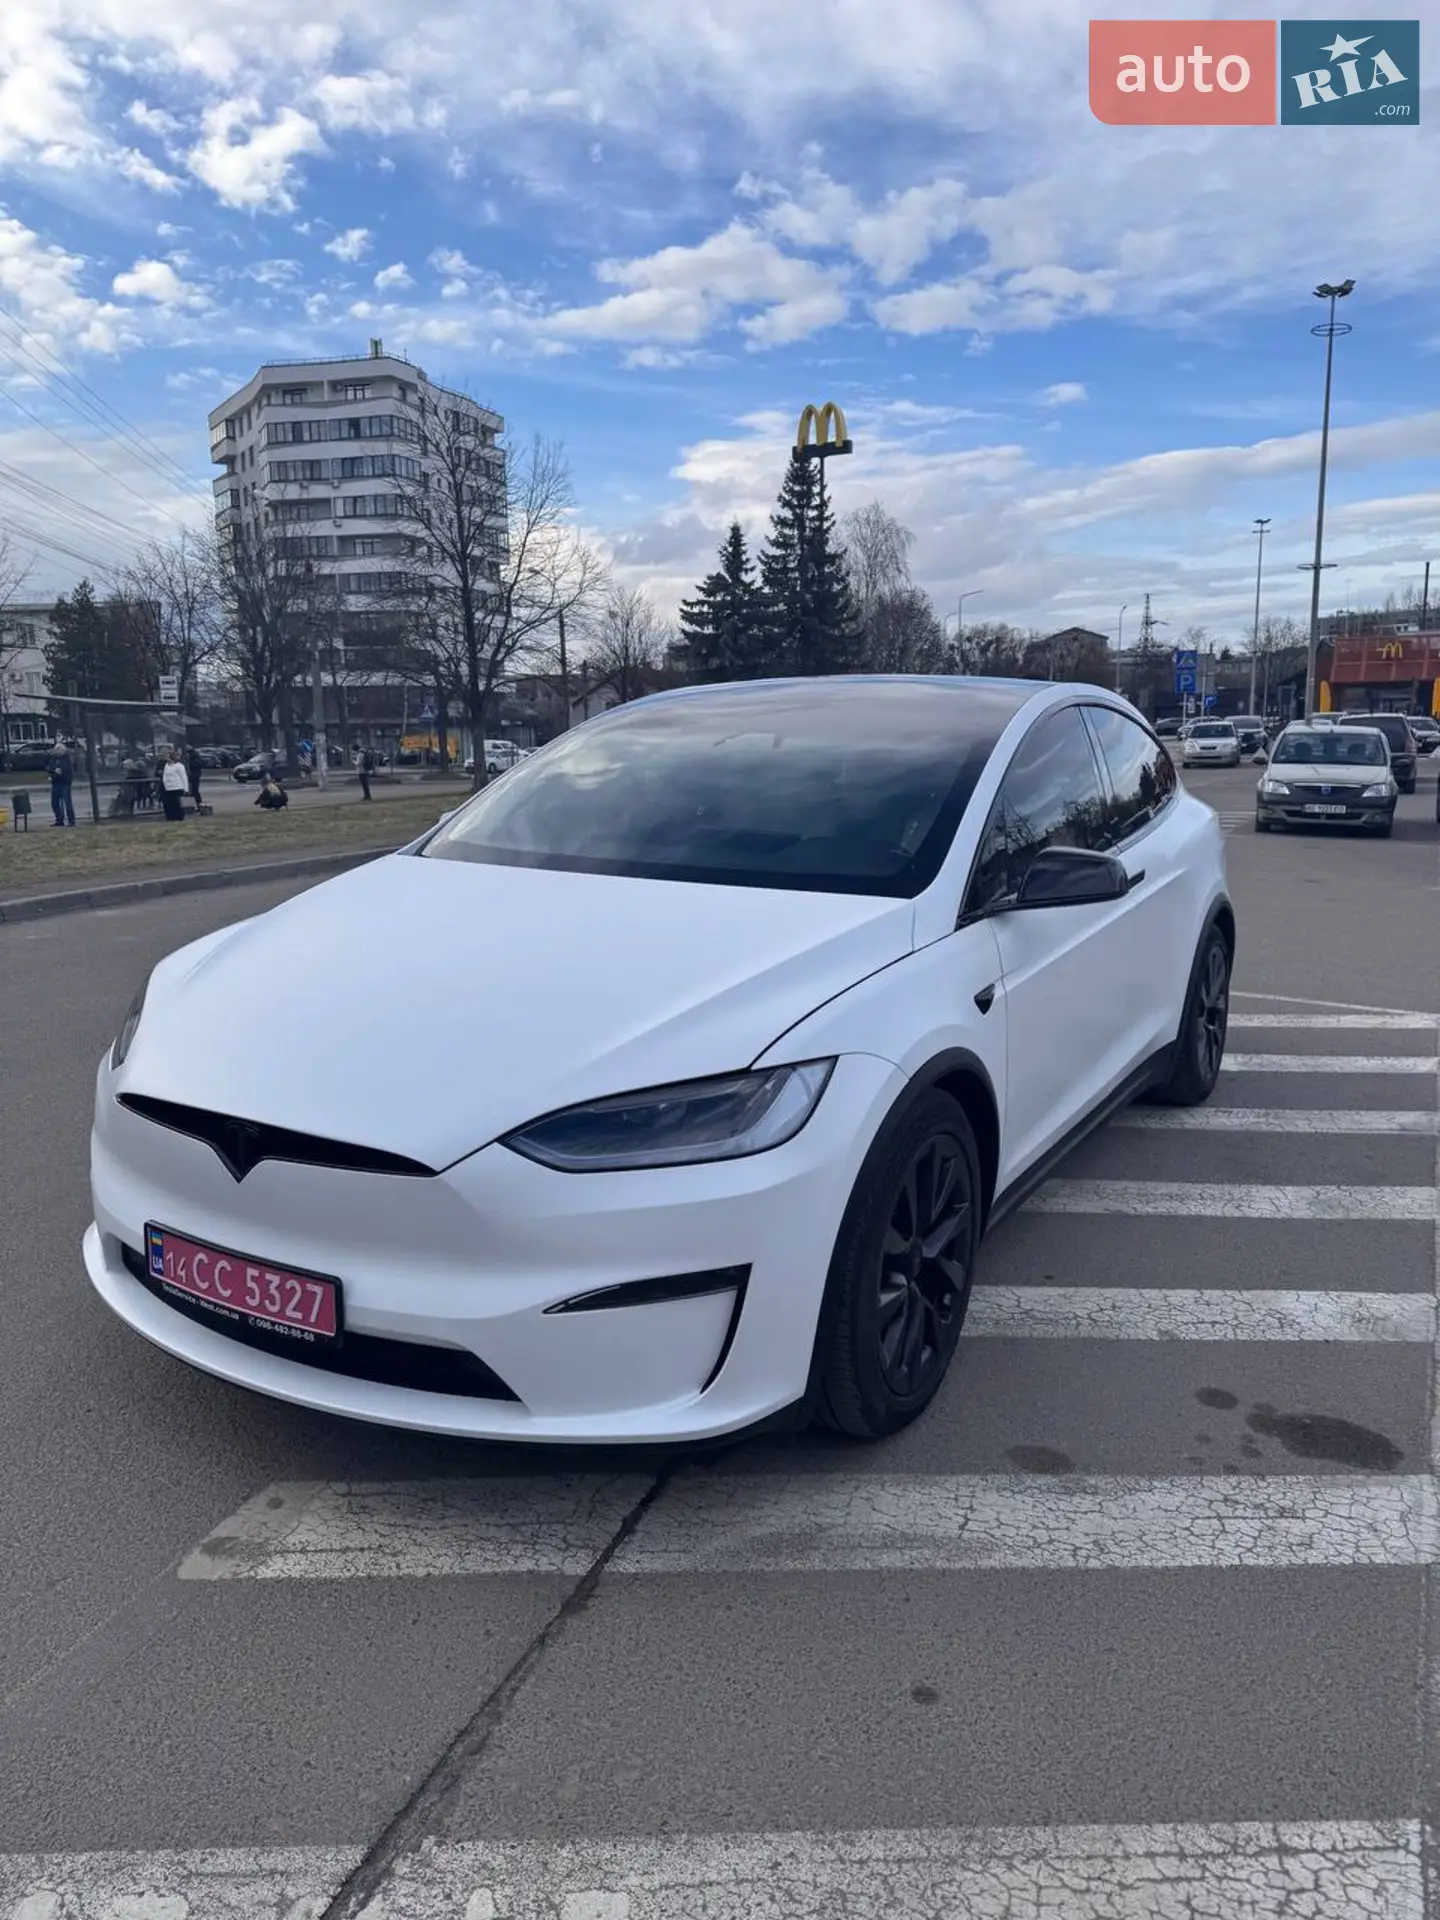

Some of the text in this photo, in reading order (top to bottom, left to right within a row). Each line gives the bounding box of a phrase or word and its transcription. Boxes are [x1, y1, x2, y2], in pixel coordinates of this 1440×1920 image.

[1180, 674, 1192, 690] P
[152, 1254, 164, 1272] UA
[245, 1266, 323, 1323] 5327
